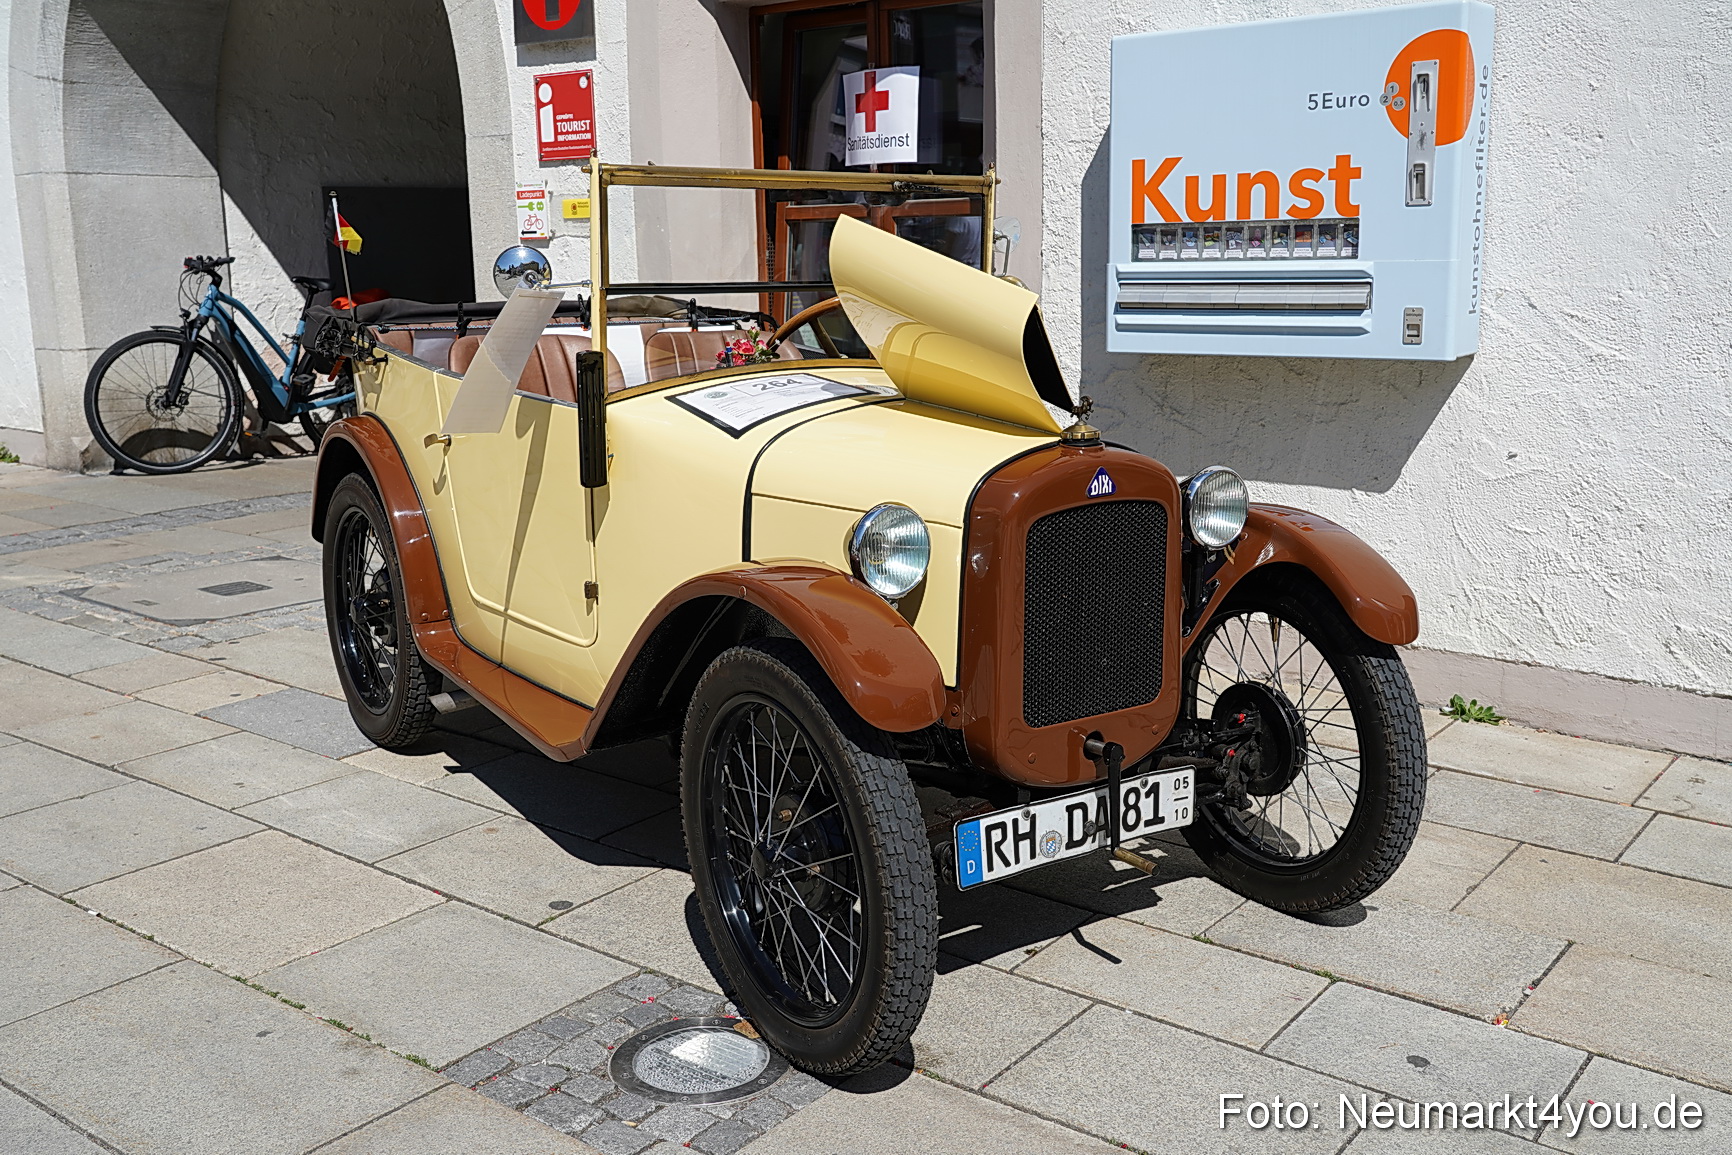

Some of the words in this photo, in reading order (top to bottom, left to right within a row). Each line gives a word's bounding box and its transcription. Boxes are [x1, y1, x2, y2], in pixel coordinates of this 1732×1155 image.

[556, 120, 591, 133] TOURIST
[557, 132, 592, 142] INFORMATION
[847, 132, 910, 152] Sanitätsdienst
[518, 191, 543, 199] Ladepunkt
[1131, 154, 1362, 224] Kunst
[1468, 64, 1488, 315] kunstohnefilter.de
[752, 378, 803, 392] 264
[1090, 474, 1112, 496] DIXI
[1173, 775, 1190, 791] 05
[1174, 806, 1189, 821] 10
[966, 859, 976, 875] D
[984, 813, 1037, 873] RH
[1121, 781, 1166, 833] 81
